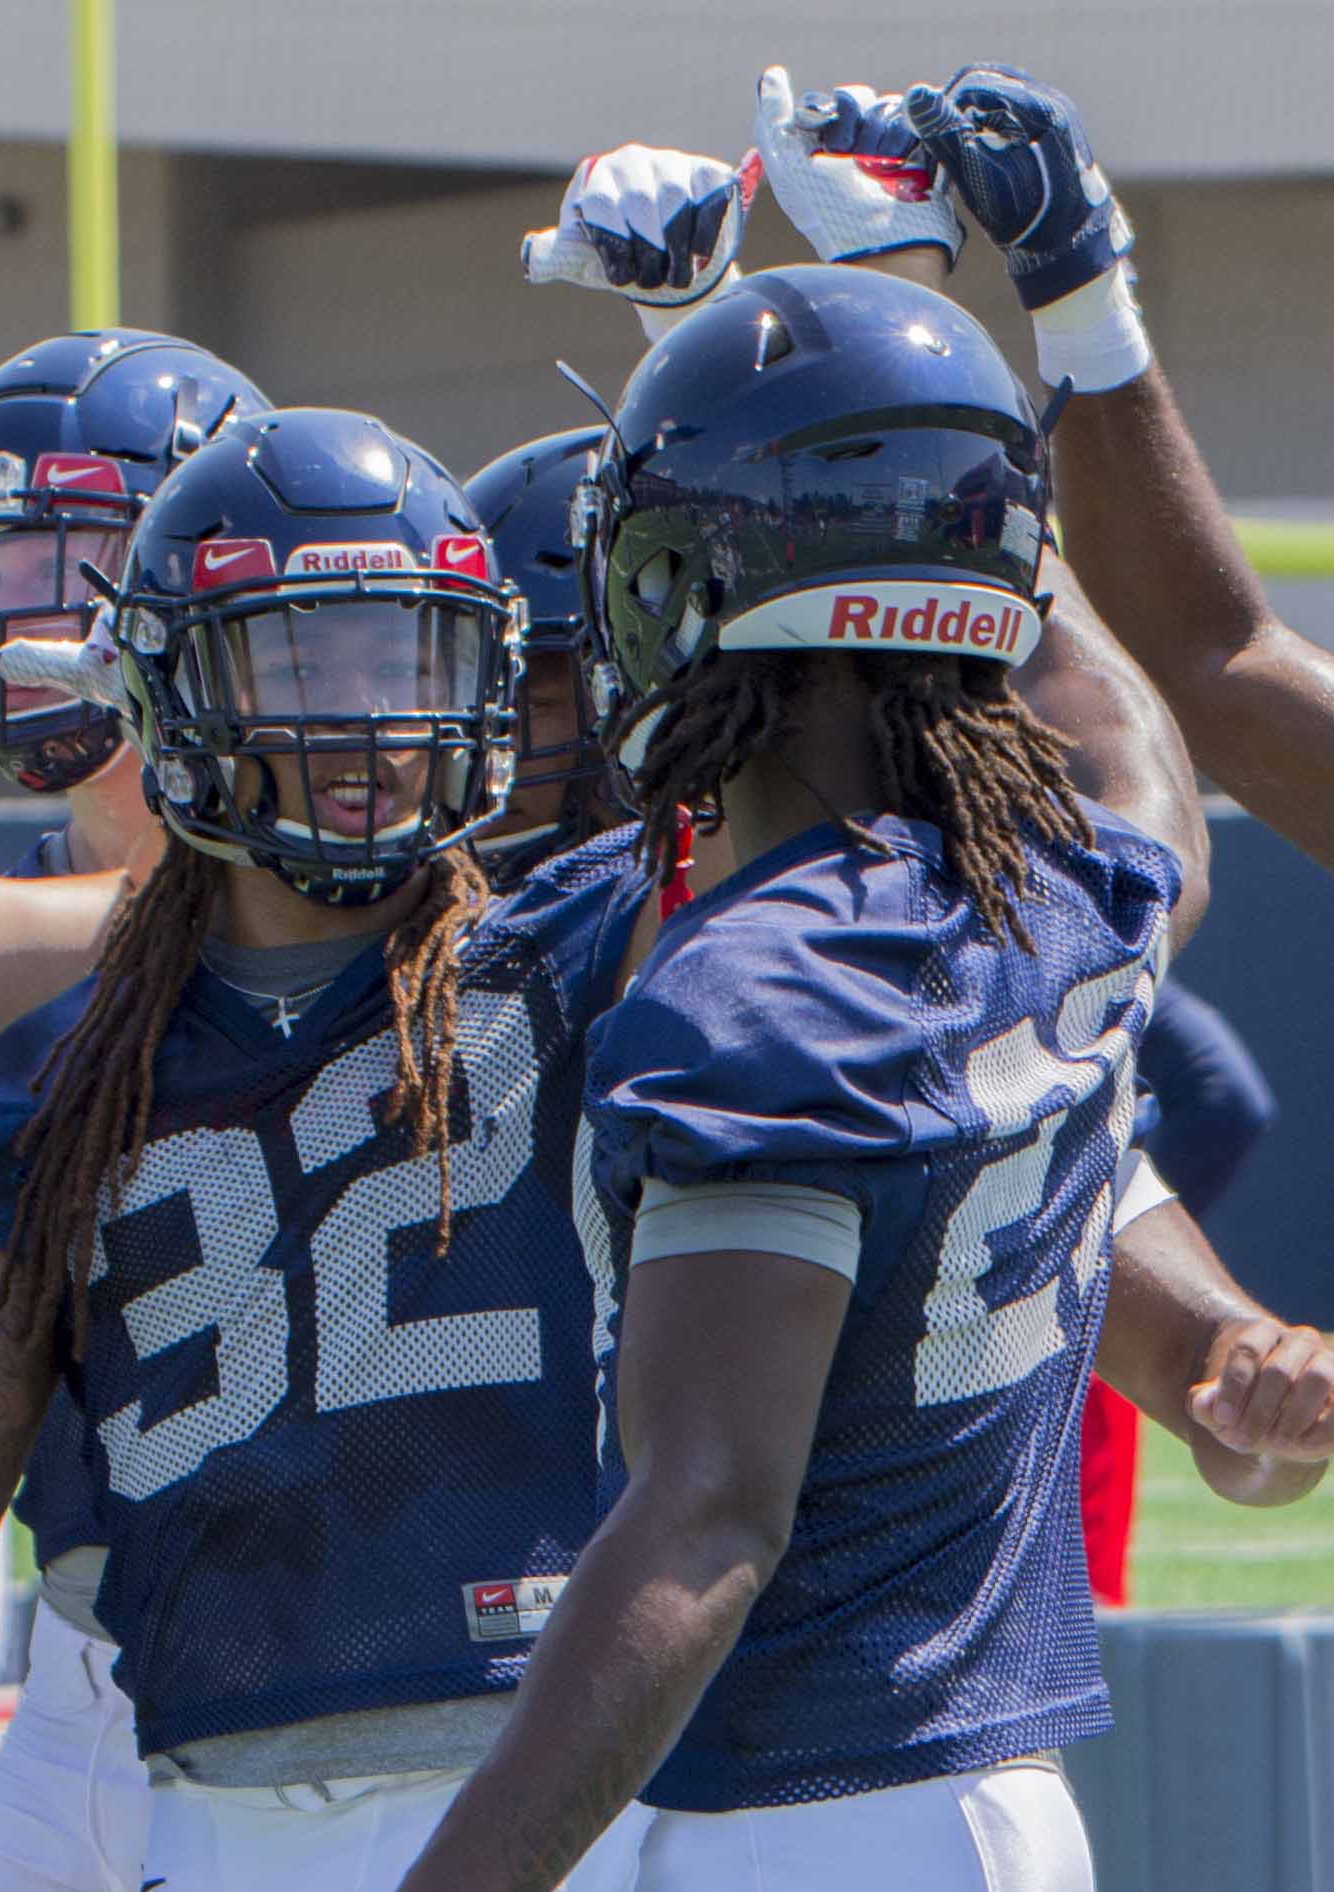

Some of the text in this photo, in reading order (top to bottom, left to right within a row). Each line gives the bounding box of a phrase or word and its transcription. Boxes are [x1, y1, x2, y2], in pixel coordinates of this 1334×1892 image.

[302, 550, 403, 572] Riddell
[828, 595, 1023, 653] Riddell
[67, 988, 543, 1502] 32
[532, 1586, 555, 1605] M
